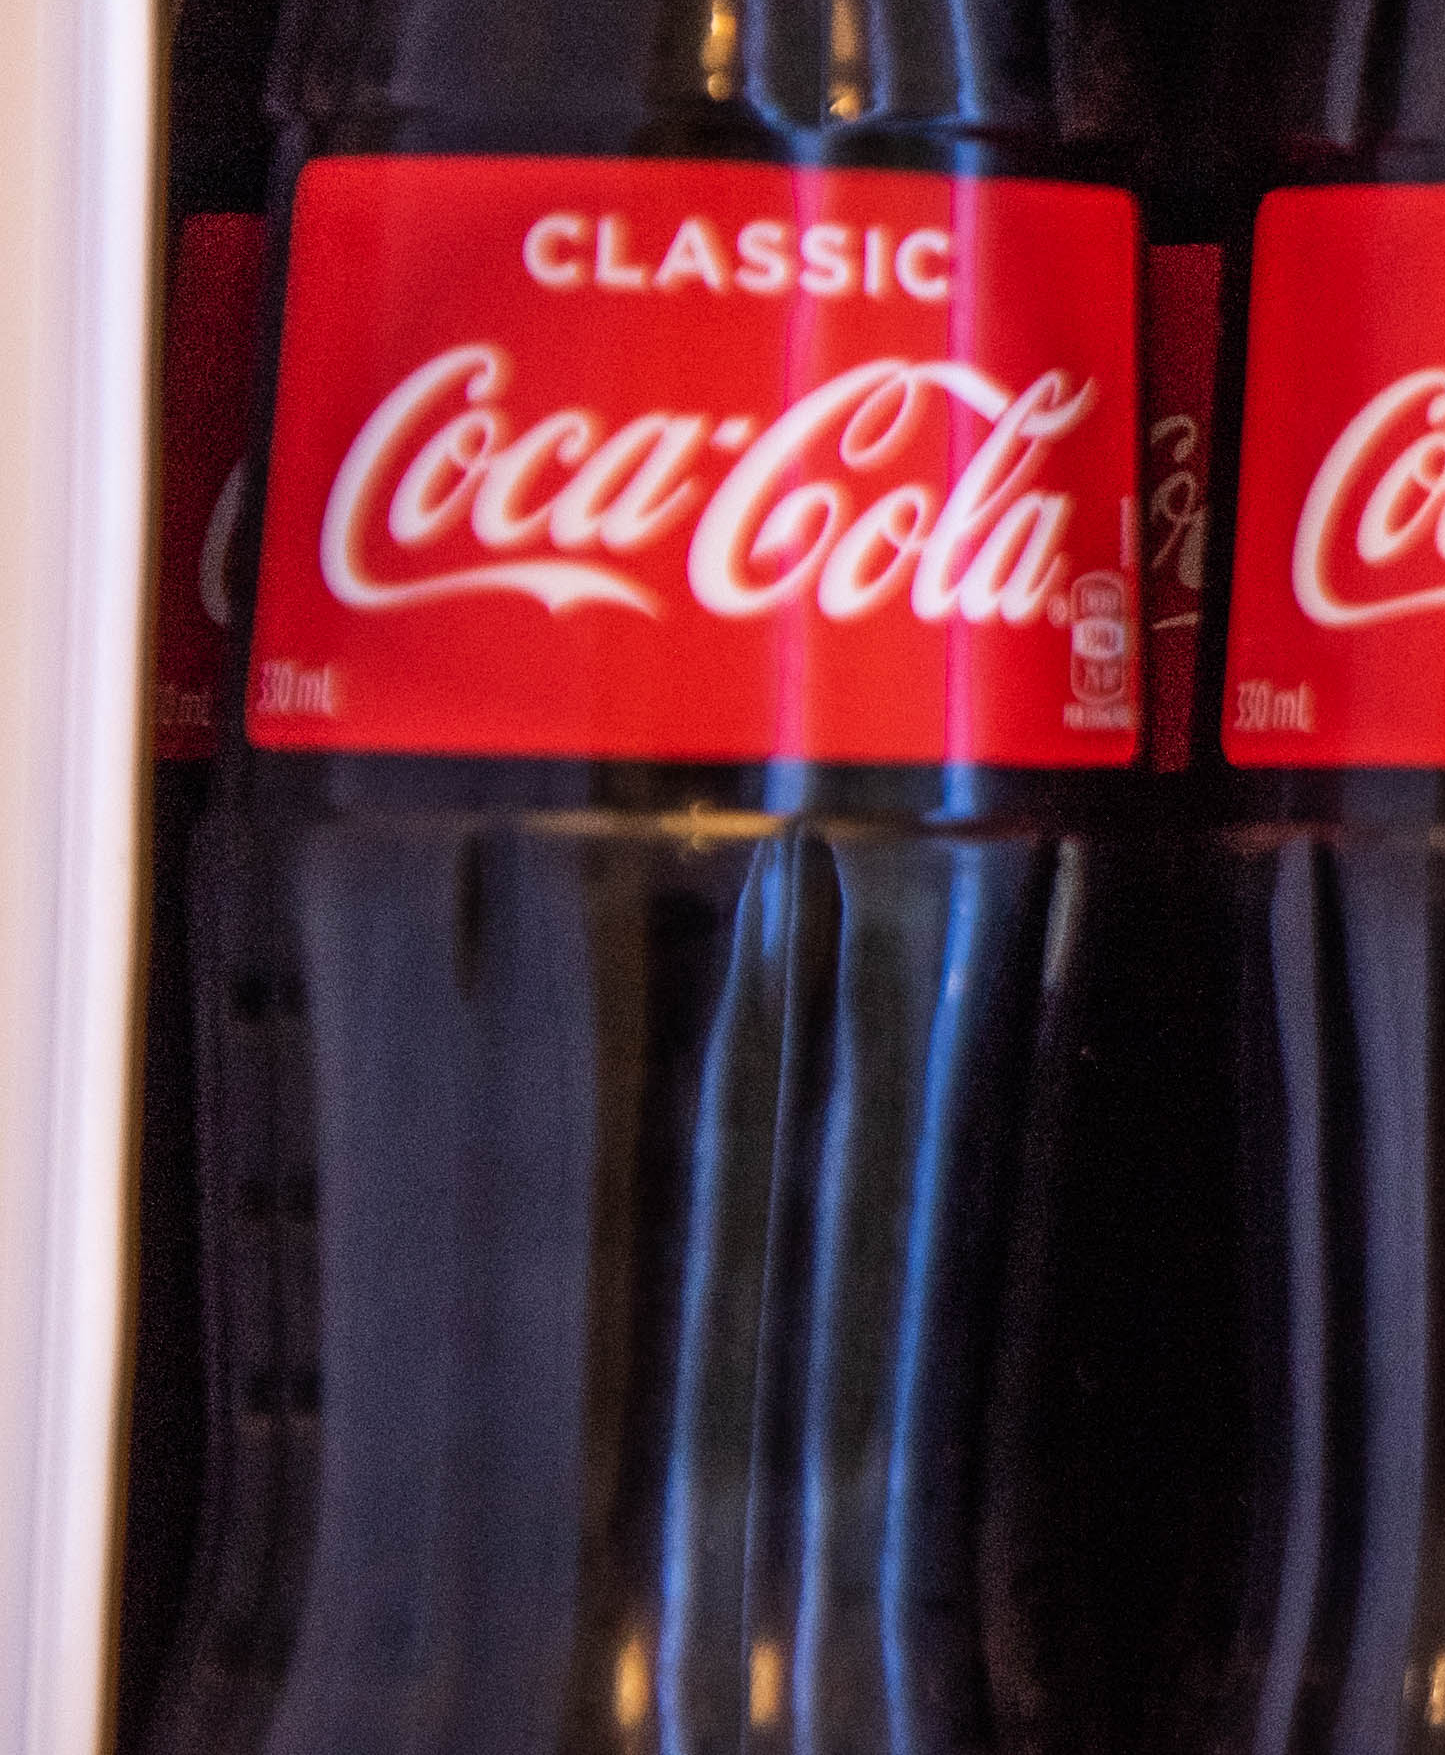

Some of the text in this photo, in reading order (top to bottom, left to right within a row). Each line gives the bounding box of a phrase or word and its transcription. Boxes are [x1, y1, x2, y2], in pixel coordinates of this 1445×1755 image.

[522, 213, 951, 302] CLASSIC
[319, 342, 1097, 623] Coca-Cola
[1233, 680, 1312, 732] 330 mL
